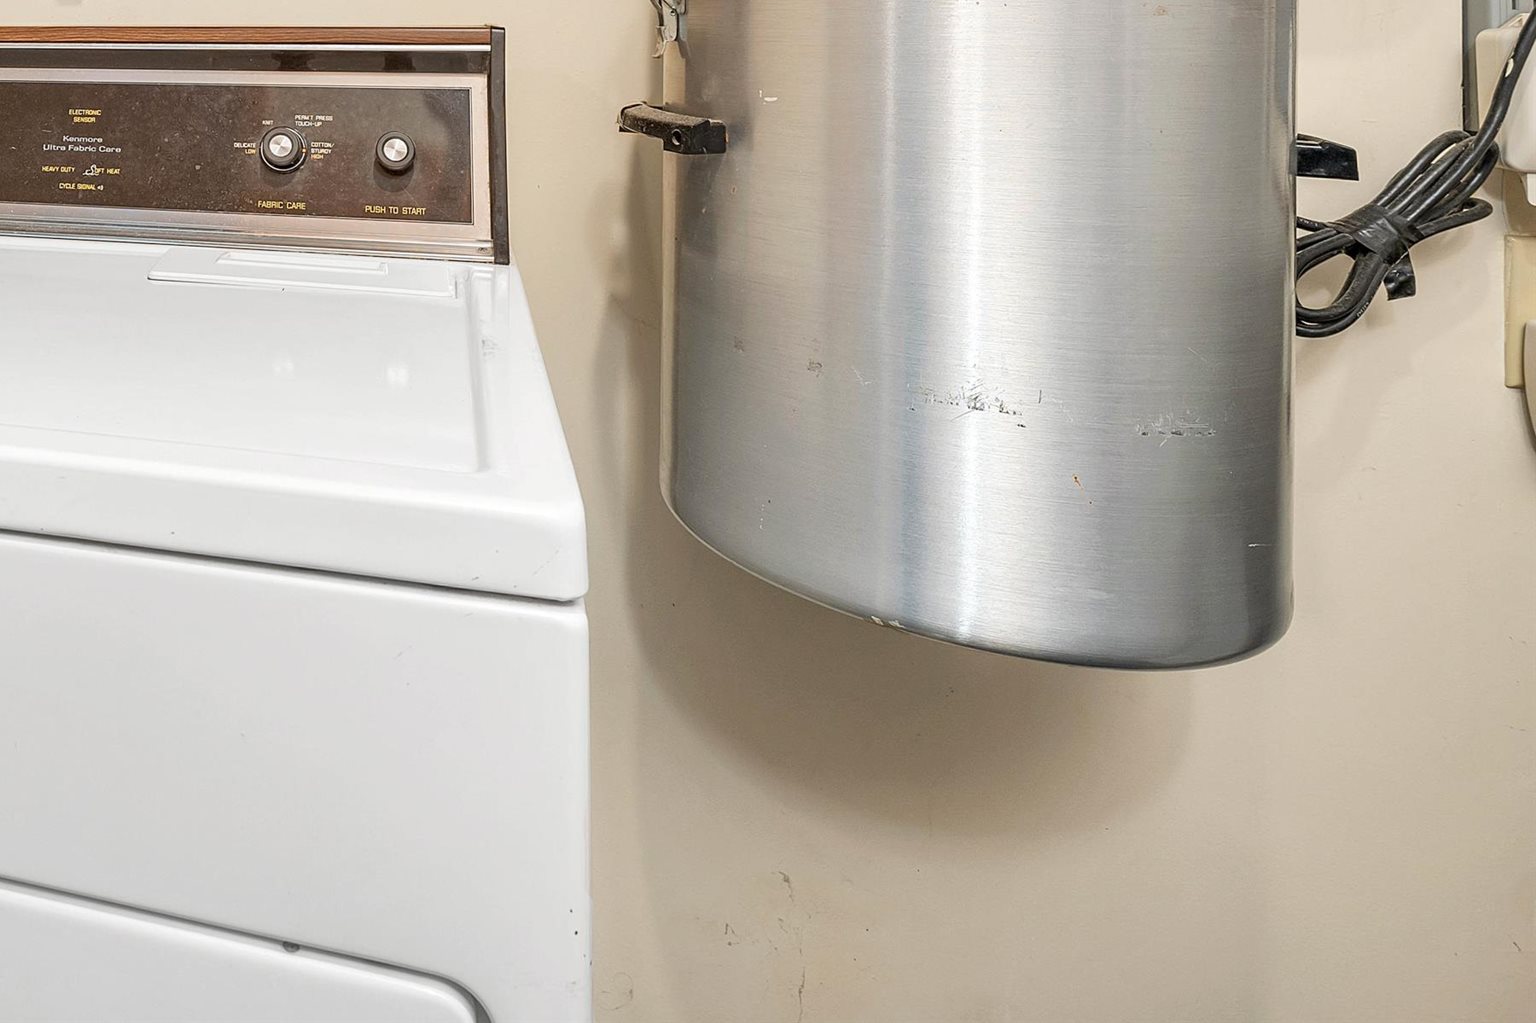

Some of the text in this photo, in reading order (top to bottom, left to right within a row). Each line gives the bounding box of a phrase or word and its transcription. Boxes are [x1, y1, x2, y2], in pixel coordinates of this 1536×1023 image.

[62, 135, 104, 143] Kenmore
[68, 144, 97, 152] Fabric
[98, 145, 122, 153] Care
[257, 200, 306, 210] FABRIC CARE
[365, 205, 427, 216] PUSH TO START
